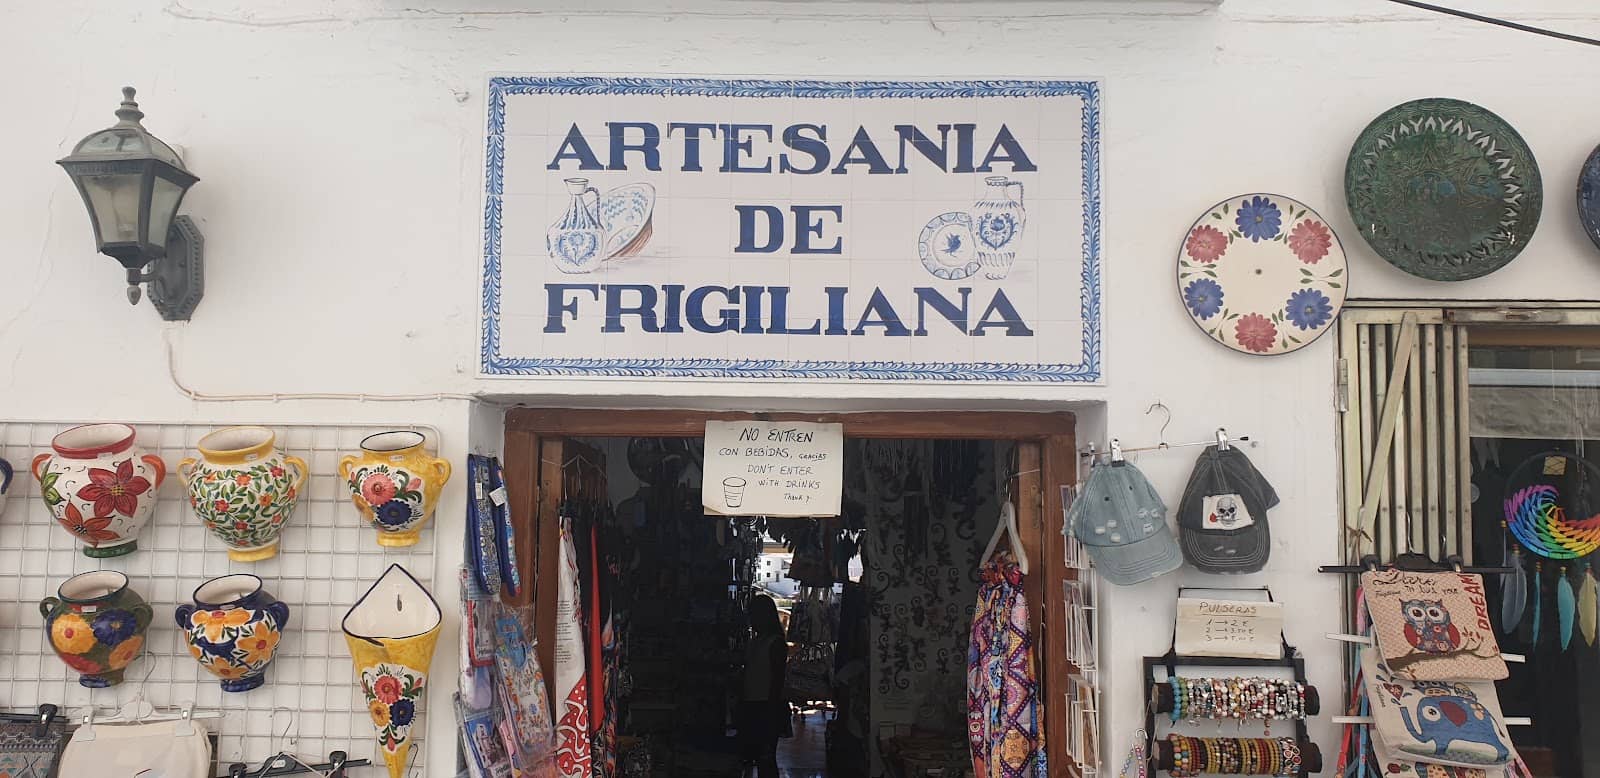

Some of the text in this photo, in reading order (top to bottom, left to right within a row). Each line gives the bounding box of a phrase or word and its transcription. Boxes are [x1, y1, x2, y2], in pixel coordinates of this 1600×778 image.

[546, 121, 1038, 175] ARTESANIA
[734, 204, 843, 255] DE
[542, 283, 1034, 337] FRIGILIANA
[719, 447, 738, 456] CON
[739, 427, 814, 443] NO ENTREN
[779, 465, 814, 475] ENTER
[1457, 572, 1490, 631] DREAM
